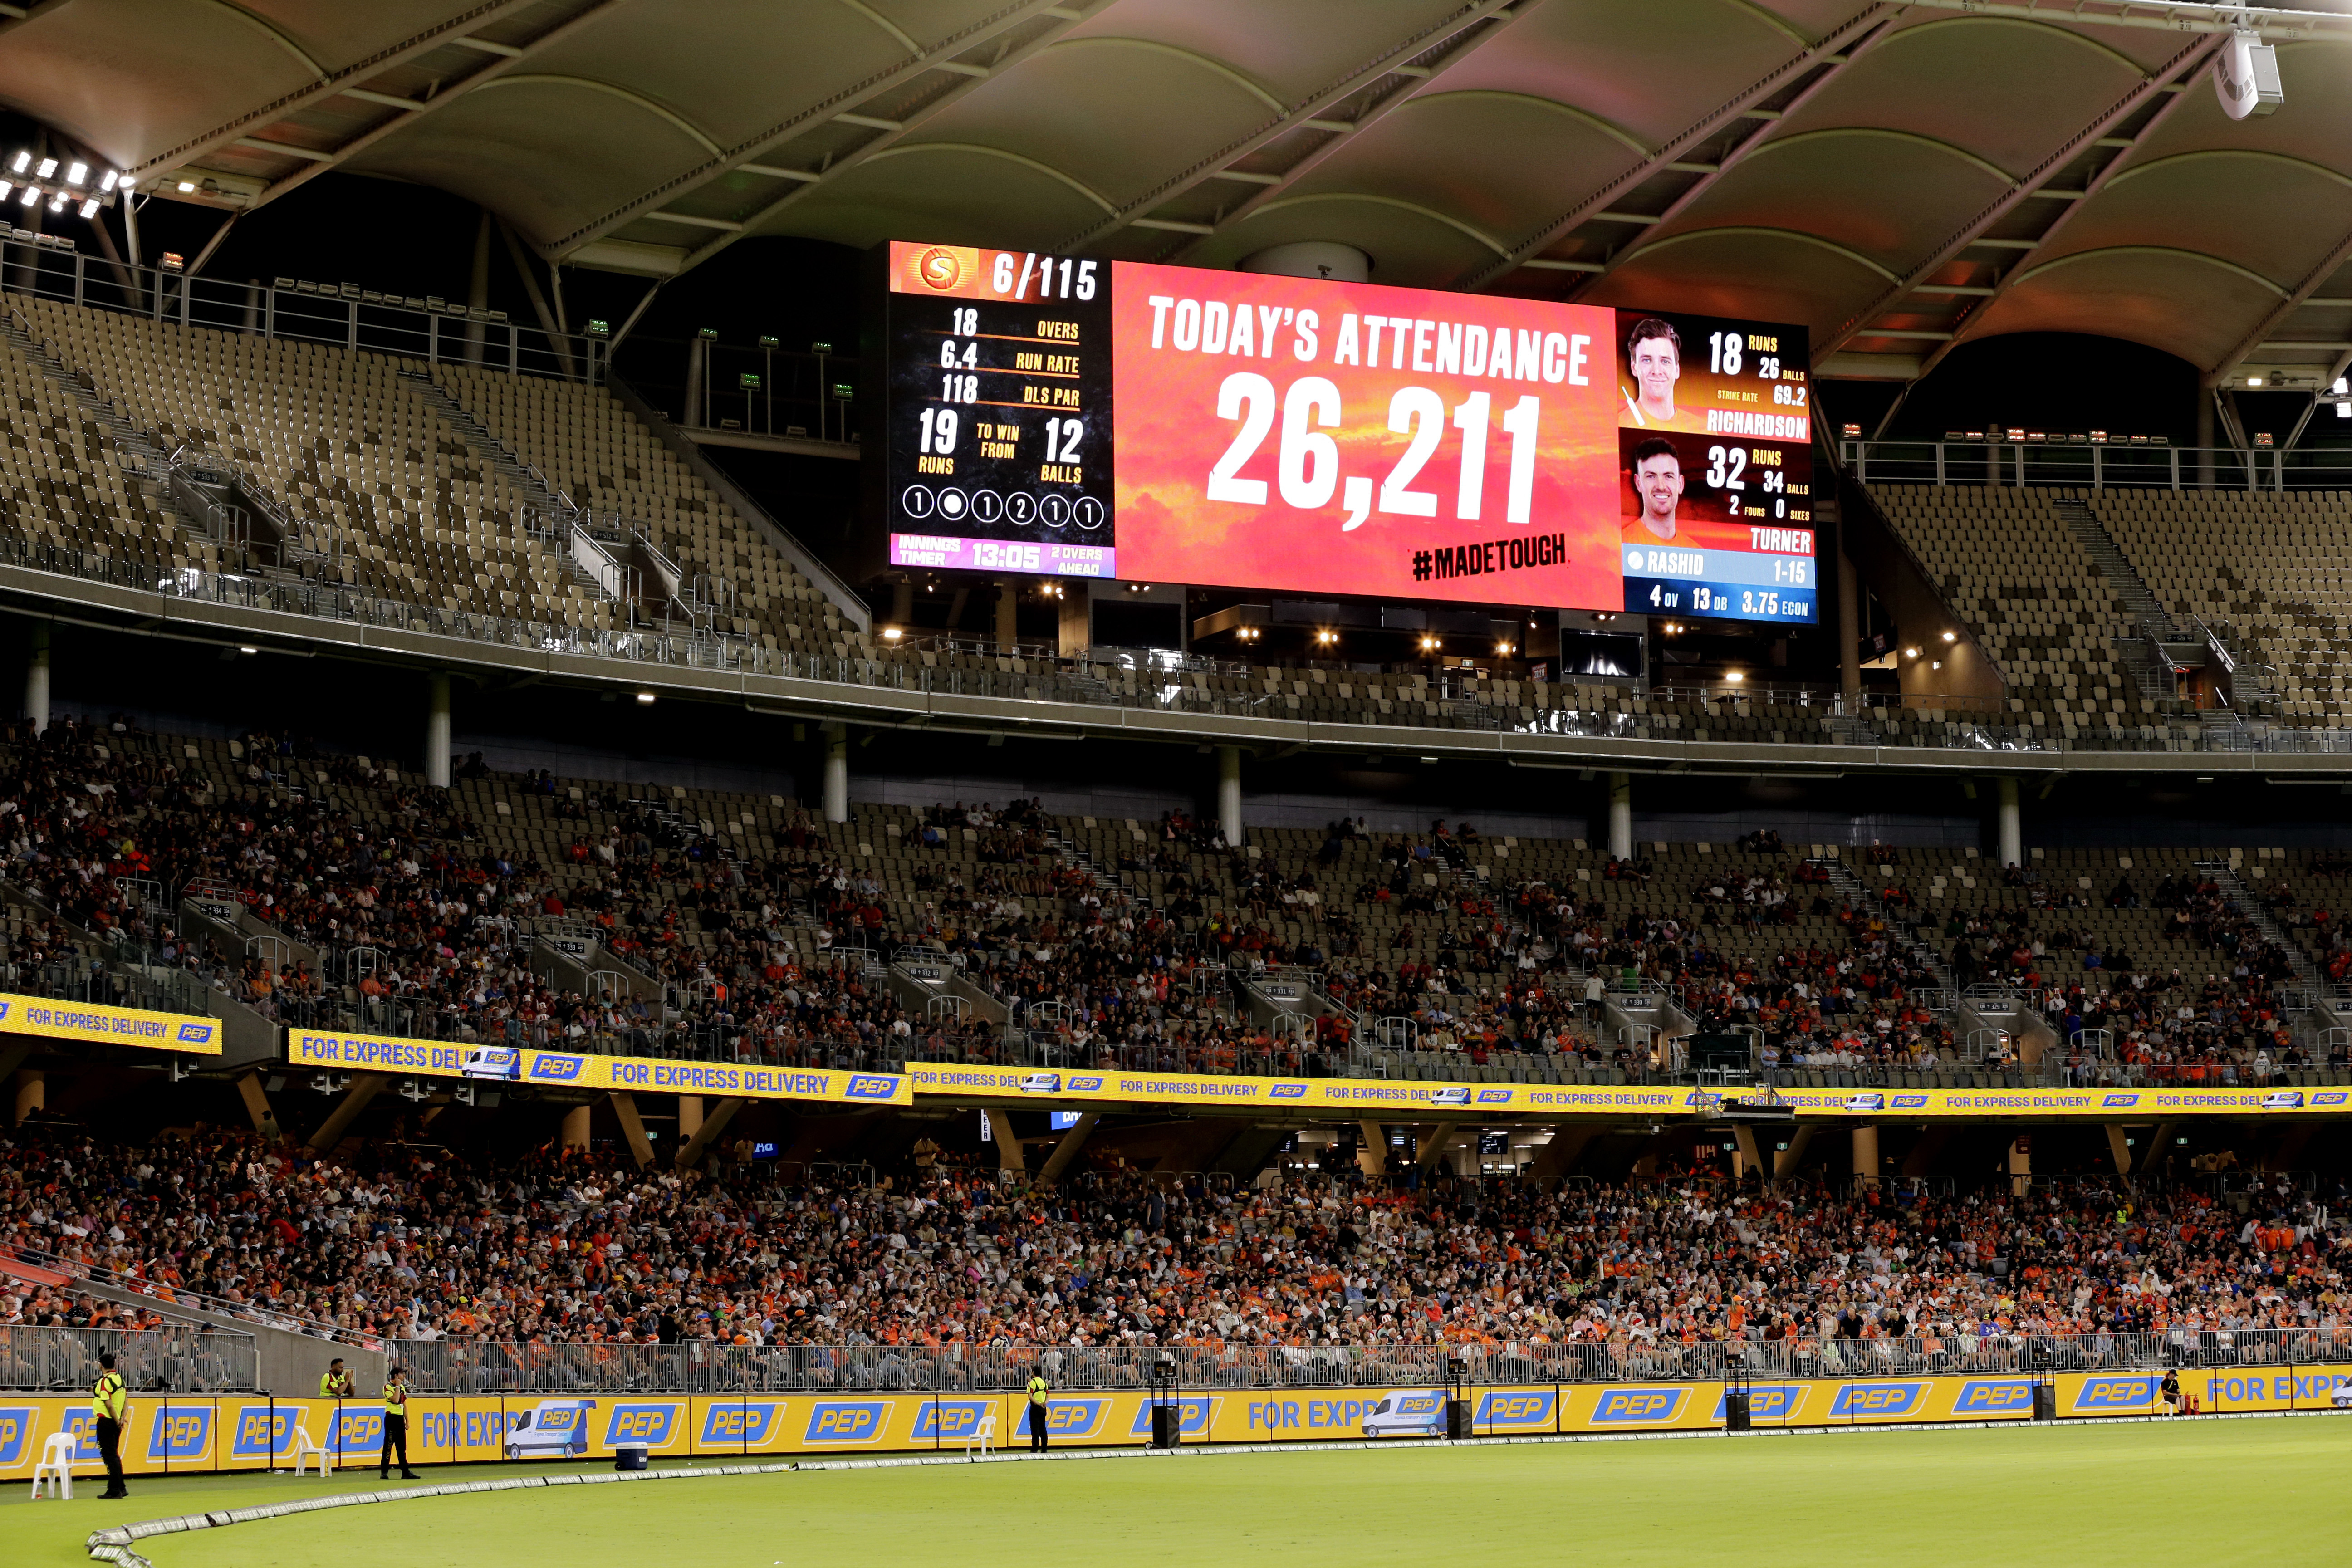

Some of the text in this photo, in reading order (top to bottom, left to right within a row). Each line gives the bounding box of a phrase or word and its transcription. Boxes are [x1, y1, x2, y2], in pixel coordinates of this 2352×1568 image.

[992, 253, 1097, 300] 6/115
[953, 308, 1079, 339] 18 OVERS
[1148, 295, 1592, 387] TODAY'S ATTENDANCE
[940, 340, 1079, 373] 6.4 RUN RATE
[1709, 332, 1778, 375] 18 RUNS
[1759, 357, 1805, 381] 26 BALLS
[942, 374, 1080, 406] 118 DLS PAR
[1717, 385, 1807, 407] STRIKE RATE 69.2
[920, 407, 958, 454] 19
[977, 423, 1019, 441] TO WIN
[1707, 410, 1807, 439] RICHARDSON
[981, 441, 1015, 459] FROM
[1045, 417, 1084, 464] 12
[1206, 372, 1540, 532] 26,211
[918, 456, 954, 475] RUNS
[1040, 465, 1082, 484] BALLS
[1706, 446, 1782, 490] 32 RUNS
[1763, 471, 1808, 495] 34 BALLS
[915, 492, 1092, 523] 1 1 2 1 1
[1729, 495, 1810, 521] 2 FOURS 0 SIXES
[898, 536, 961, 552] INNINGS
[1750, 527, 1811, 554] TURNER
[900, 550, 946, 566] TIMER
[972, 543, 1041, 569] 13:05
[1051, 546, 1103, 560] 2 OVERS
[1412, 533, 1566, 582] #MADETOUGH
[1058, 562, 1099, 575] AHEAD
[1647, 551, 1806, 583] RASHID 1-15
[1650, 585, 1808, 616] 4 OV 13 DB 3.75 ECON
[27, 1008, 51, 1025] FOR
[54, 1011, 109, 1032] EXPRESS
[112, 1018, 167, 1038] DELIVERY
[182, 1027, 207, 1039] PEP
[302, 1036, 474, 1069] FOR EXPRESS DELI
[488, 1053, 509, 1063] PEP
[537, 1059, 575, 1076] PEP
[612, 1062, 830, 1094] FOR EXPRESS DELIVERY
[913, 1071, 937, 1083] FOR
[941, 1073, 996, 1086] EXPRESS
[853, 1078, 892, 1095] PEP
[1071, 1078, 1099, 1088] PEP
[1120, 1080, 1258, 1096] FOR EXPRESS DELIVERY
[1275, 1086, 1303, 1096] PEP
[1325, 1087, 1350, 1099] FOR
[1353, 1088, 1407, 1100] EXPRESS
[1481, 1092, 1508, 1101] PEP
[1529, 1093, 1673, 1106] FOR EXPRESS DELIVERY
[1775, 1096, 1821, 1107] PRESS
[1895, 1097, 1922, 1106] PEP
[1946, 1096, 2091, 1107] FOR EXPRESS DELIVERY
[2108, 1096, 2134, 1105] PEP
[2157, 1096, 2180, 1106] FOR
[2183, 1095, 2237, 1106] EXPRESS
[2315, 1094, 2344, 1103] PEP
[1842, 1389, 1906, 1409] PEP
[1968, 1386, 2028, 1405] PEP
[2088, 1382, 2148, 1401] PEP
[2207, 1377, 2265, 1401] FOR
[1402, 1399, 1434, 1411] PEP
[1486, 1397, 1543, 1418] PEP
[1605, 1395, 1666, 1415] PEP
[1749, 1392, 1784, 1411] EP
[542, 1411, 571, 1425] PEP
[616, 1411, 665, 1436] PEP
[711, 1411, 762, 1435] PEP
[817, 1410, 872, 1433] PEP
[923, 1408, 975, 1431] PEP
[1249, 1401, 1300, 1429] FOR
[70, 1418, 97, 1449] PE
[159, 1416, 201, 1446] PEP
[242, 1415, 287, 1445] PEP
[334, 1415, 382, 1444] PEP
[423, 1413, 461, 1448] FOR
